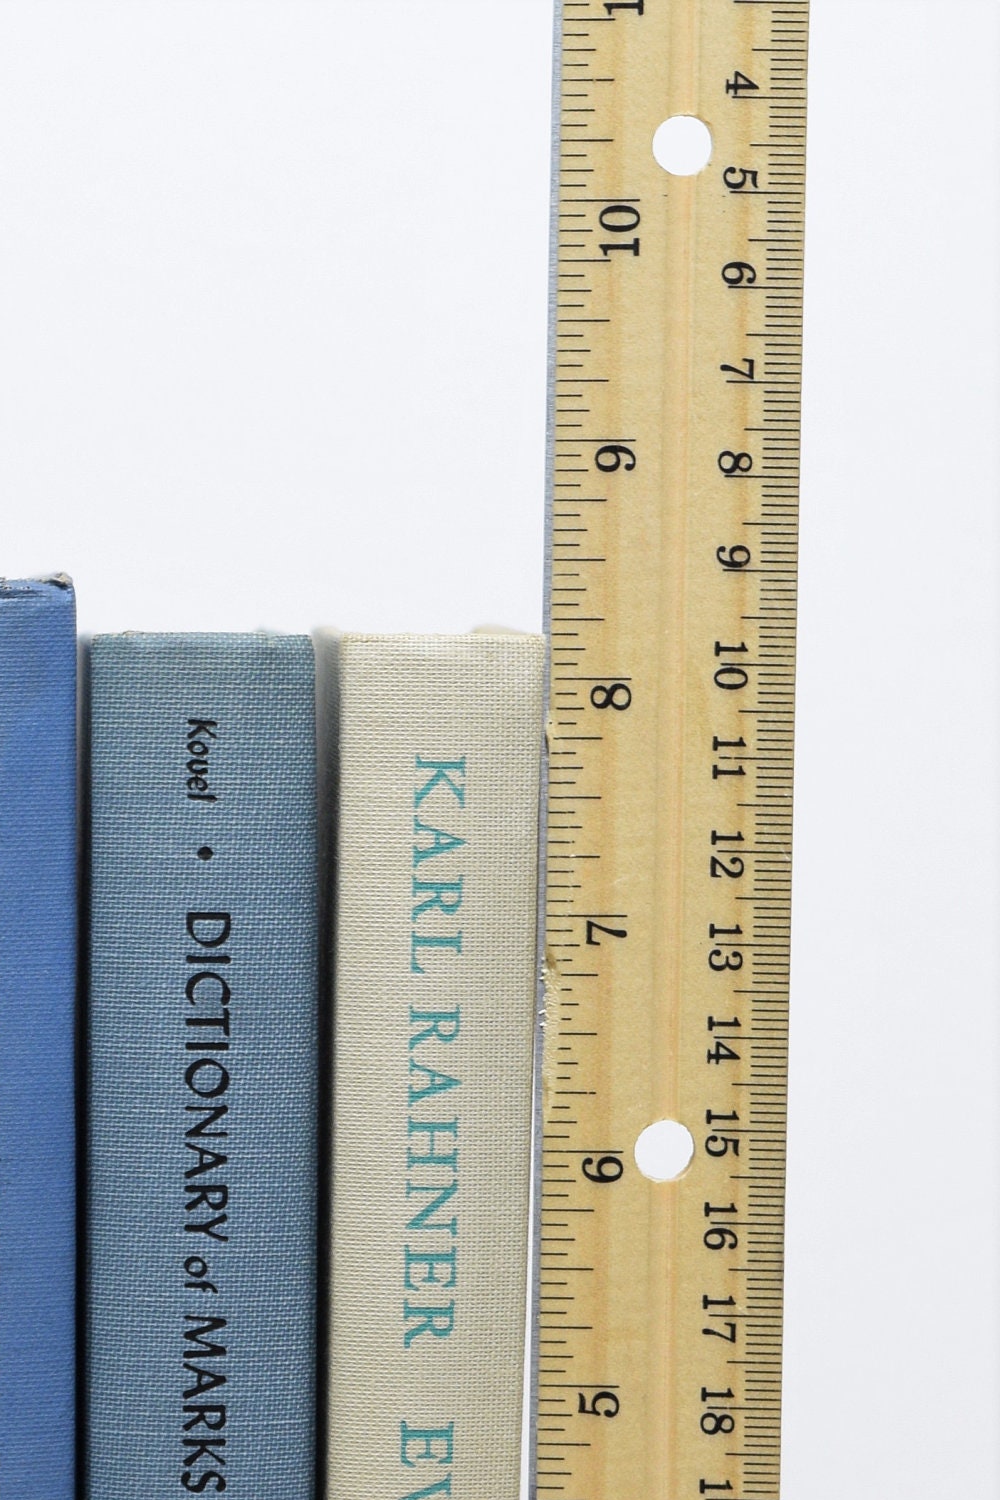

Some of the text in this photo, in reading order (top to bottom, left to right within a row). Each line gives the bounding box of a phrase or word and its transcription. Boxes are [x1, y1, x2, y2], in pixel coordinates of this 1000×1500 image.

[725, 70, 759, 95] 4
[722, 167, 758, 190] 5
[599, 204, 640, 256] 10
[721, 262, 756, 285] 6
[720, 358, 754, 381] 7
[595, 444, 636, 472] 9
[717, 450, 753, 473] 8
[716, 545, 751, 568] 9
[713, 641, 748, 690] 10
[590, 683, 632, 710] 8
[186, 719, 217, 802] Kovel
[712, 736, 747, 780] 11
[411, 756, 466, 973] KARL
[710, 830, 745, 878] 12
[585, 919, 627, 946] 7
[708, 923, 743, 972] 13
[706, 1016, 742, 1065] 14
[184, 912, 231, 1242] DICTIONARY
[705, 1109, 740, 1158] 15
[404, 1007, 461, 1348] RAHNER
[582, 1156, 624, 1184] 6
[703, 1202, 738, 1251] 16
[184, 1256, 218, 1293] of
[701, 1295, 737, 1344] 17
[181, 1315, 227, 1492] MARKS
[578, 1391, 620, 1418] 5
[700, 1387, 735, 1435] 18
